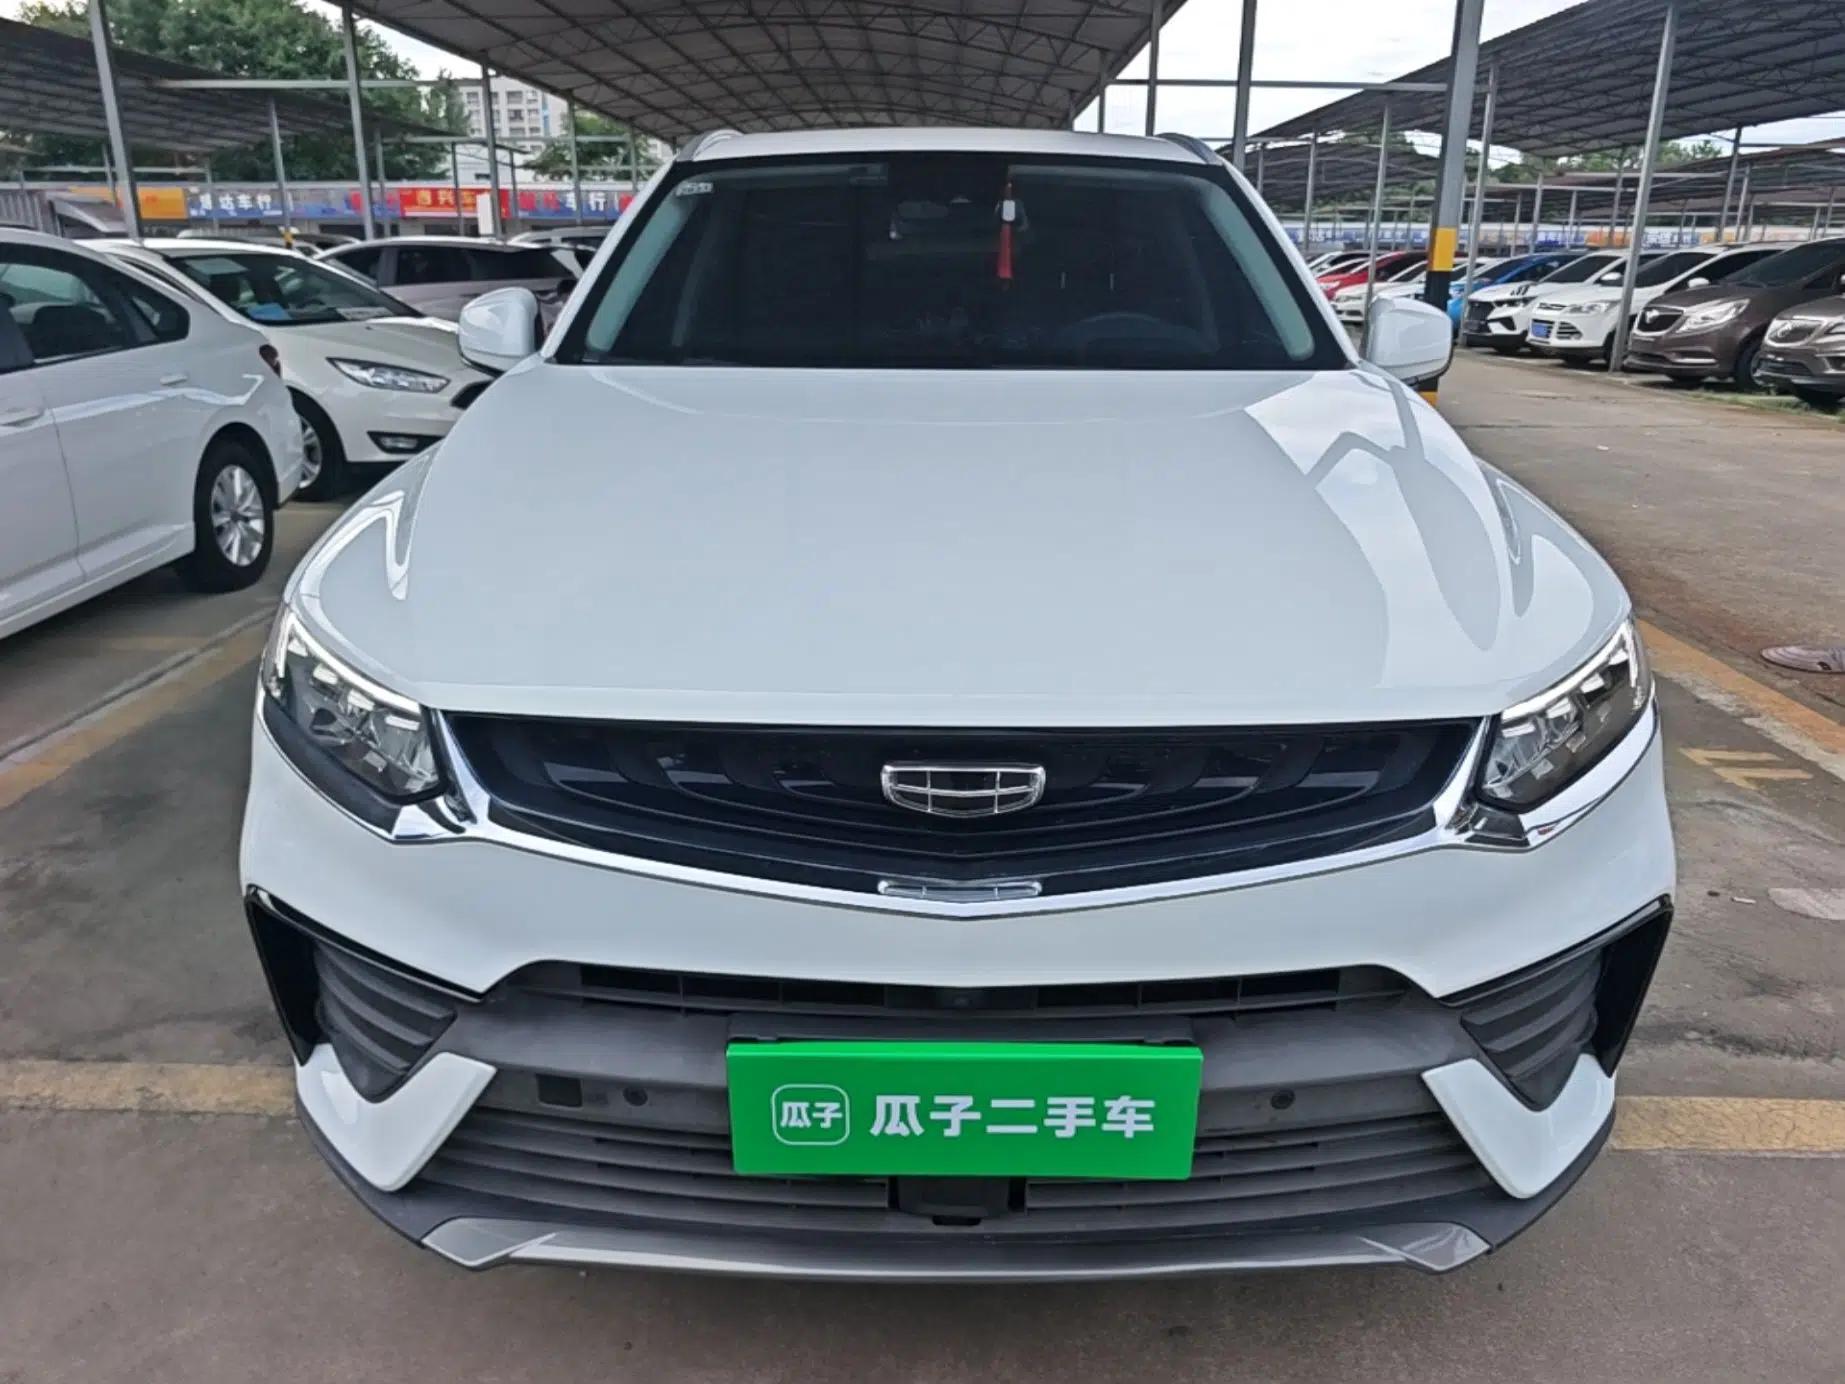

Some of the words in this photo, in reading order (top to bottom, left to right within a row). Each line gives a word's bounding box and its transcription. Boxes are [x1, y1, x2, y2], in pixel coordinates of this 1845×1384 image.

[779, 1101, 843, 1129] 瓜子
[869, 1094, 1156, 1138] 瓜子二手车
